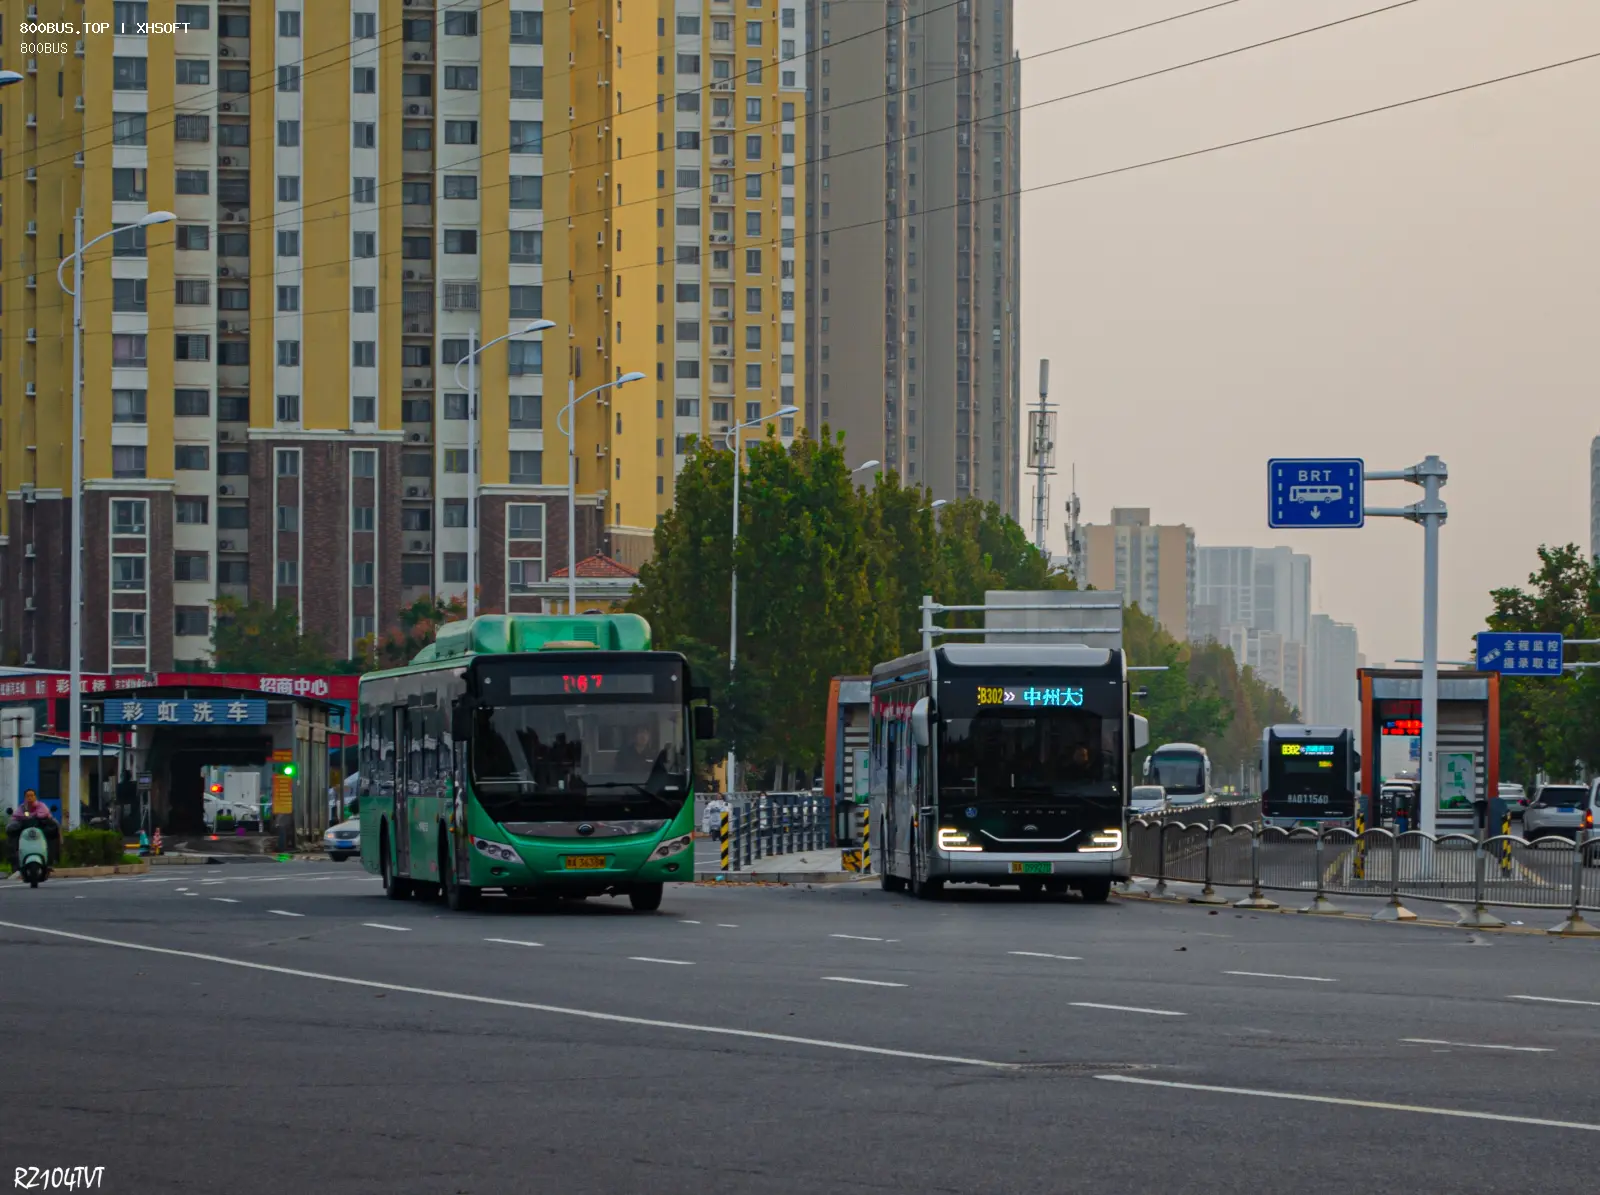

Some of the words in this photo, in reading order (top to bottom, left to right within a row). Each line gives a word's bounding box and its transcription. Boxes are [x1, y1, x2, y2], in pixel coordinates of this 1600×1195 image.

[1298, 470, 1332, 482] BRT
[1503, 639, 1559, 652] 全程监控
[259, 676, 329, 696] 招商中心
[980, 687, 1003, 704] B302
[1023, 687, 1084, 706] 中州大
[122, 702, 249, 723] 彩虹洗车
